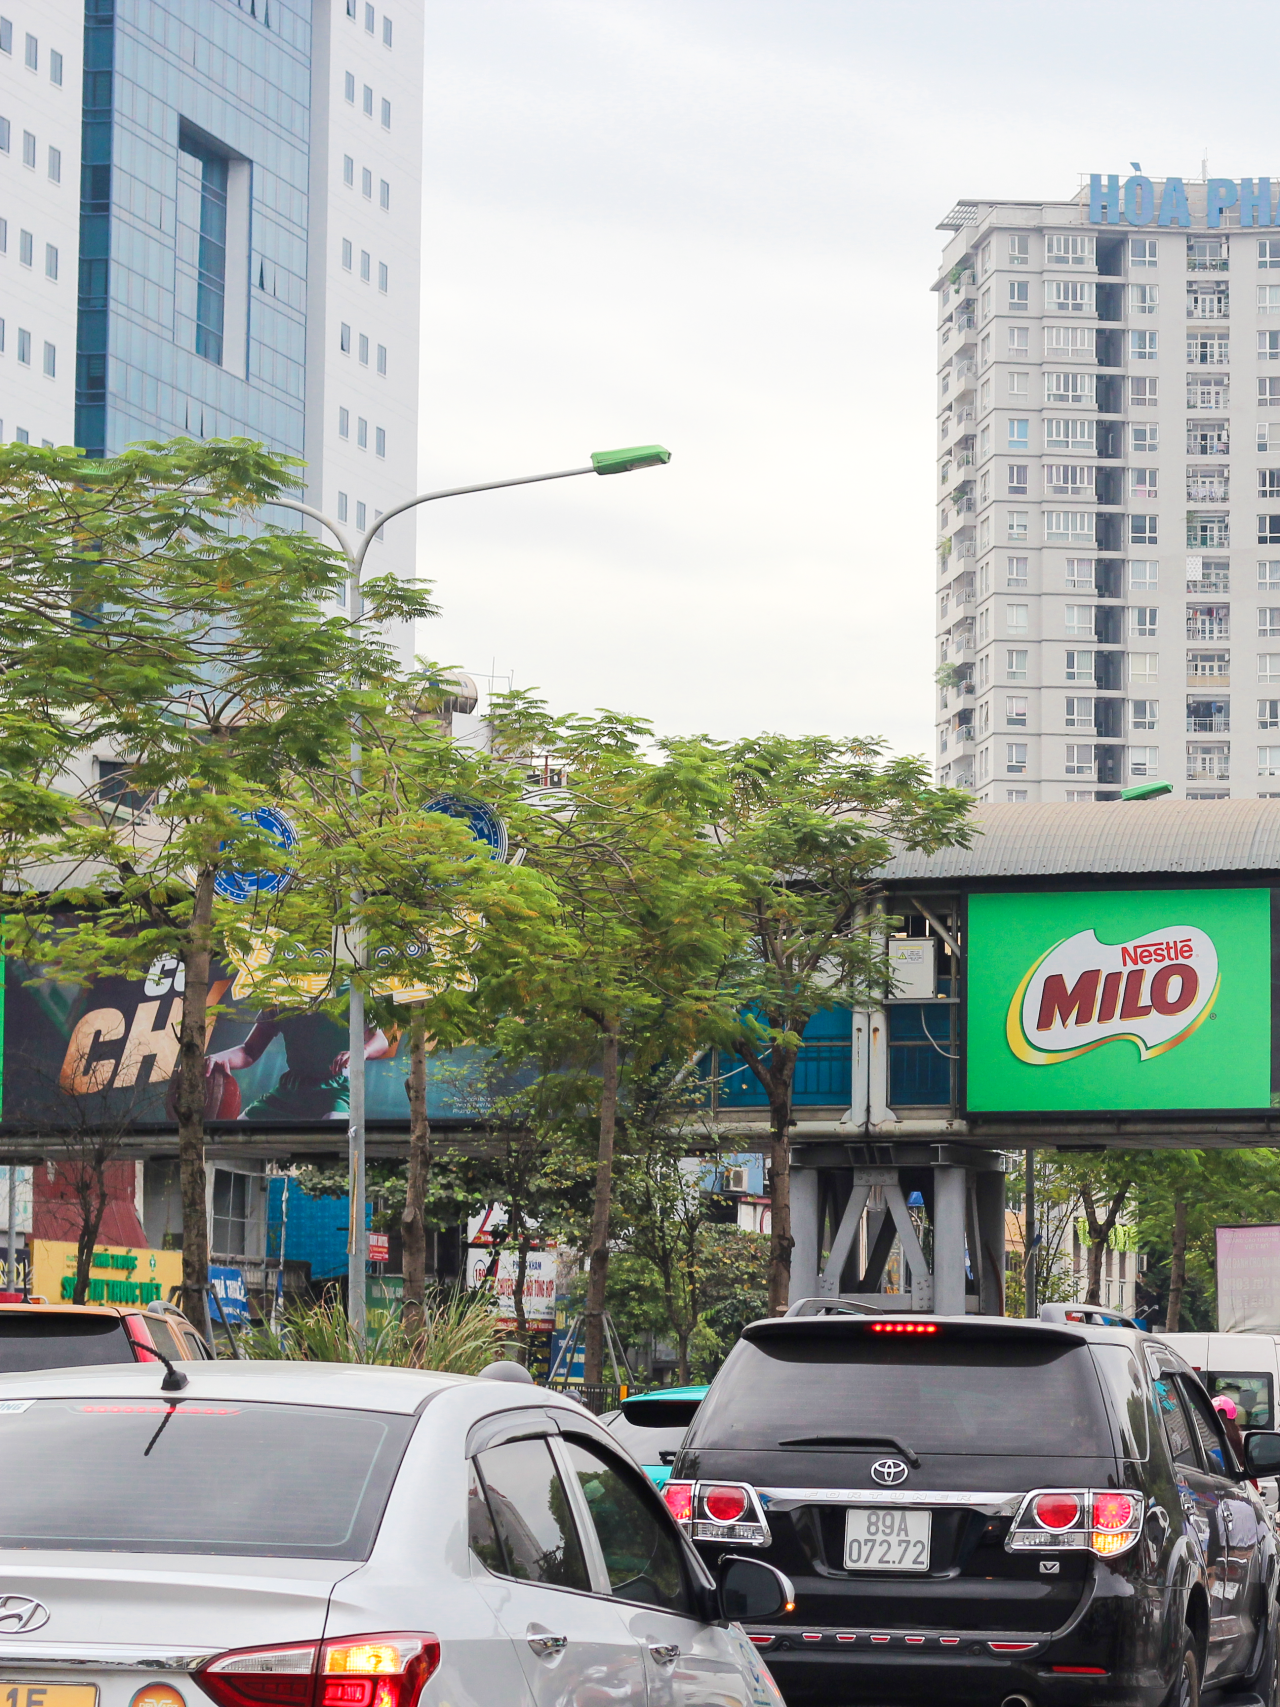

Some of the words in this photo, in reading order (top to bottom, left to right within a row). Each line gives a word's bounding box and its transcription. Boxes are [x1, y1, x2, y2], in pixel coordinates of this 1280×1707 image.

[1090, 162, 1190, 227] HÒA
[1037, 963, 1199, 1031] MILO
[804, 1491, 972, 1502] FORTUNER
[866, 1511, 909, 1537] 89A
[848, 1539, 926, 1565] 072.72
